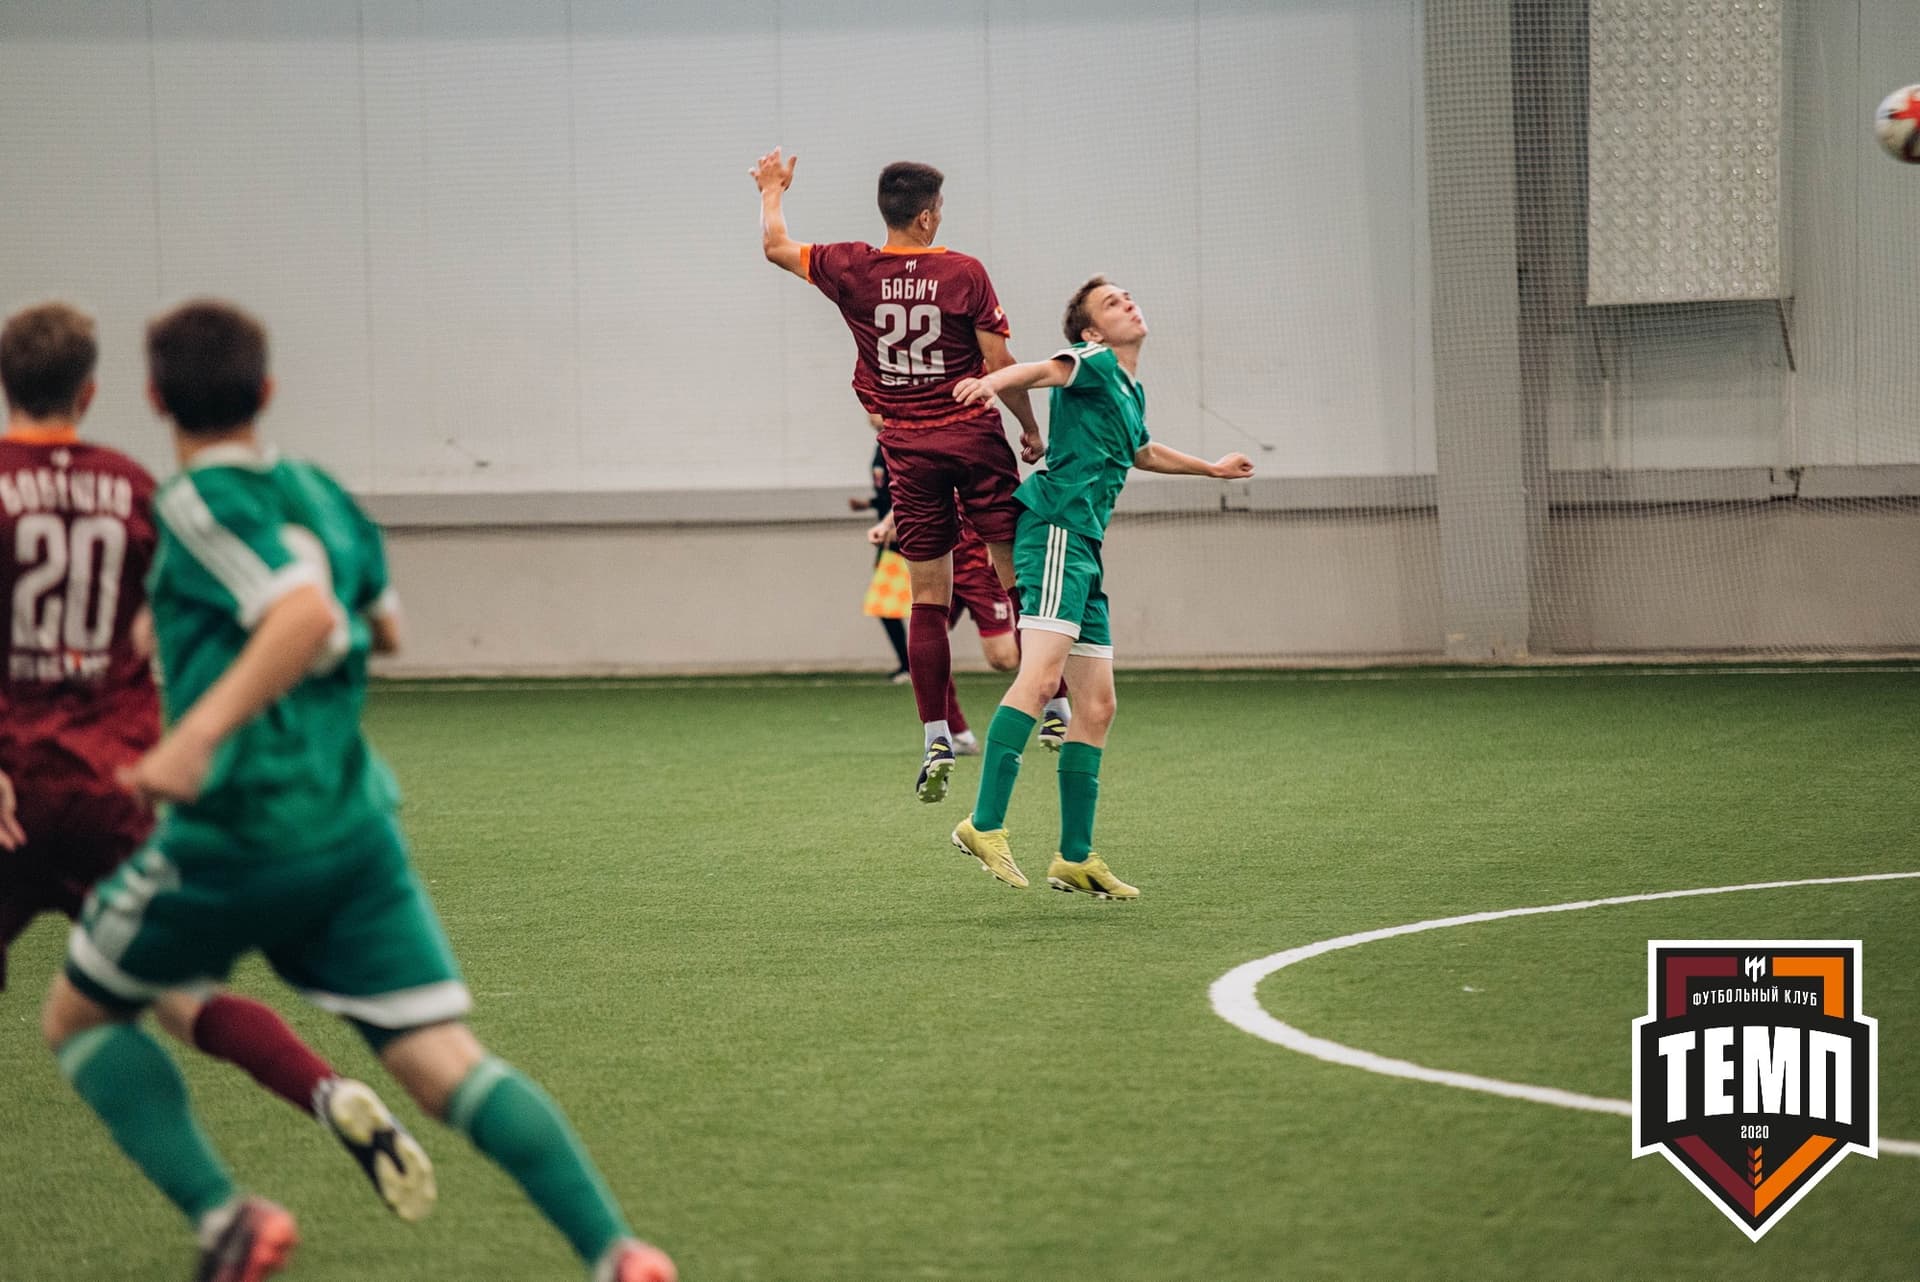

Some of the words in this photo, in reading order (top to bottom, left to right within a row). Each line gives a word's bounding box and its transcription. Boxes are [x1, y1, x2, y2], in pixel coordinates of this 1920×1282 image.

[881, 278, 938, 301] БАБИЧ
[874, 303, 946, 375] 22
[11, 512, 127, 651] 20
